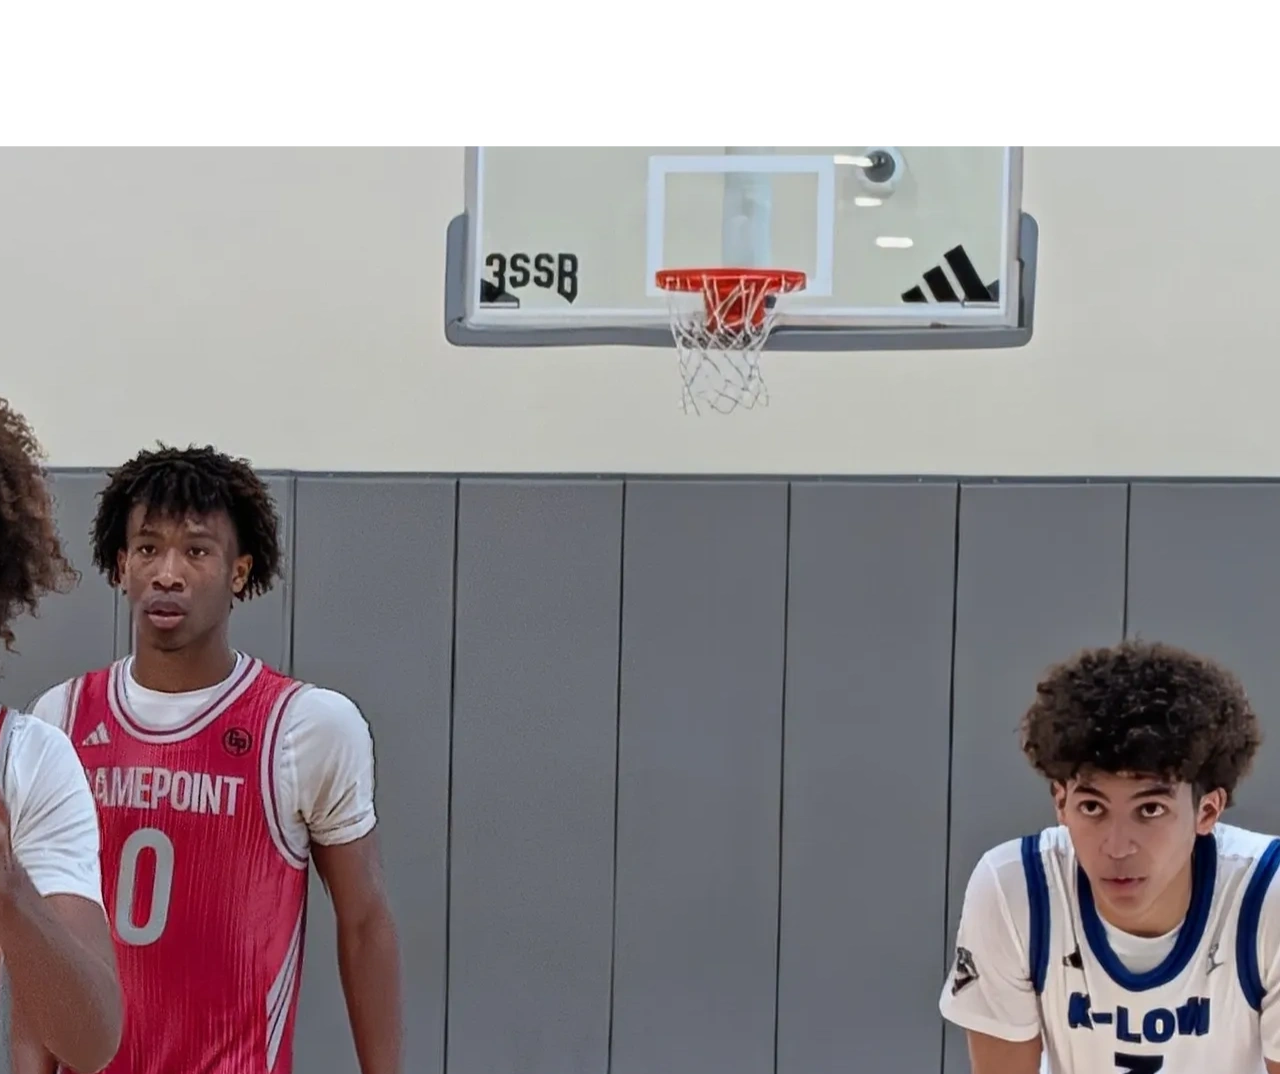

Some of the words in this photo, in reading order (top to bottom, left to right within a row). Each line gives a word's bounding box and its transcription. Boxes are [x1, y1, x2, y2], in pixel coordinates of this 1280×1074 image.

[485, 253, 578, 305] 3SSB
[86, 766, 244, 817] AMEPOINT
[115, 827, 175, 946] 0
[1068, 991, 1211, 1044] K-LOW
